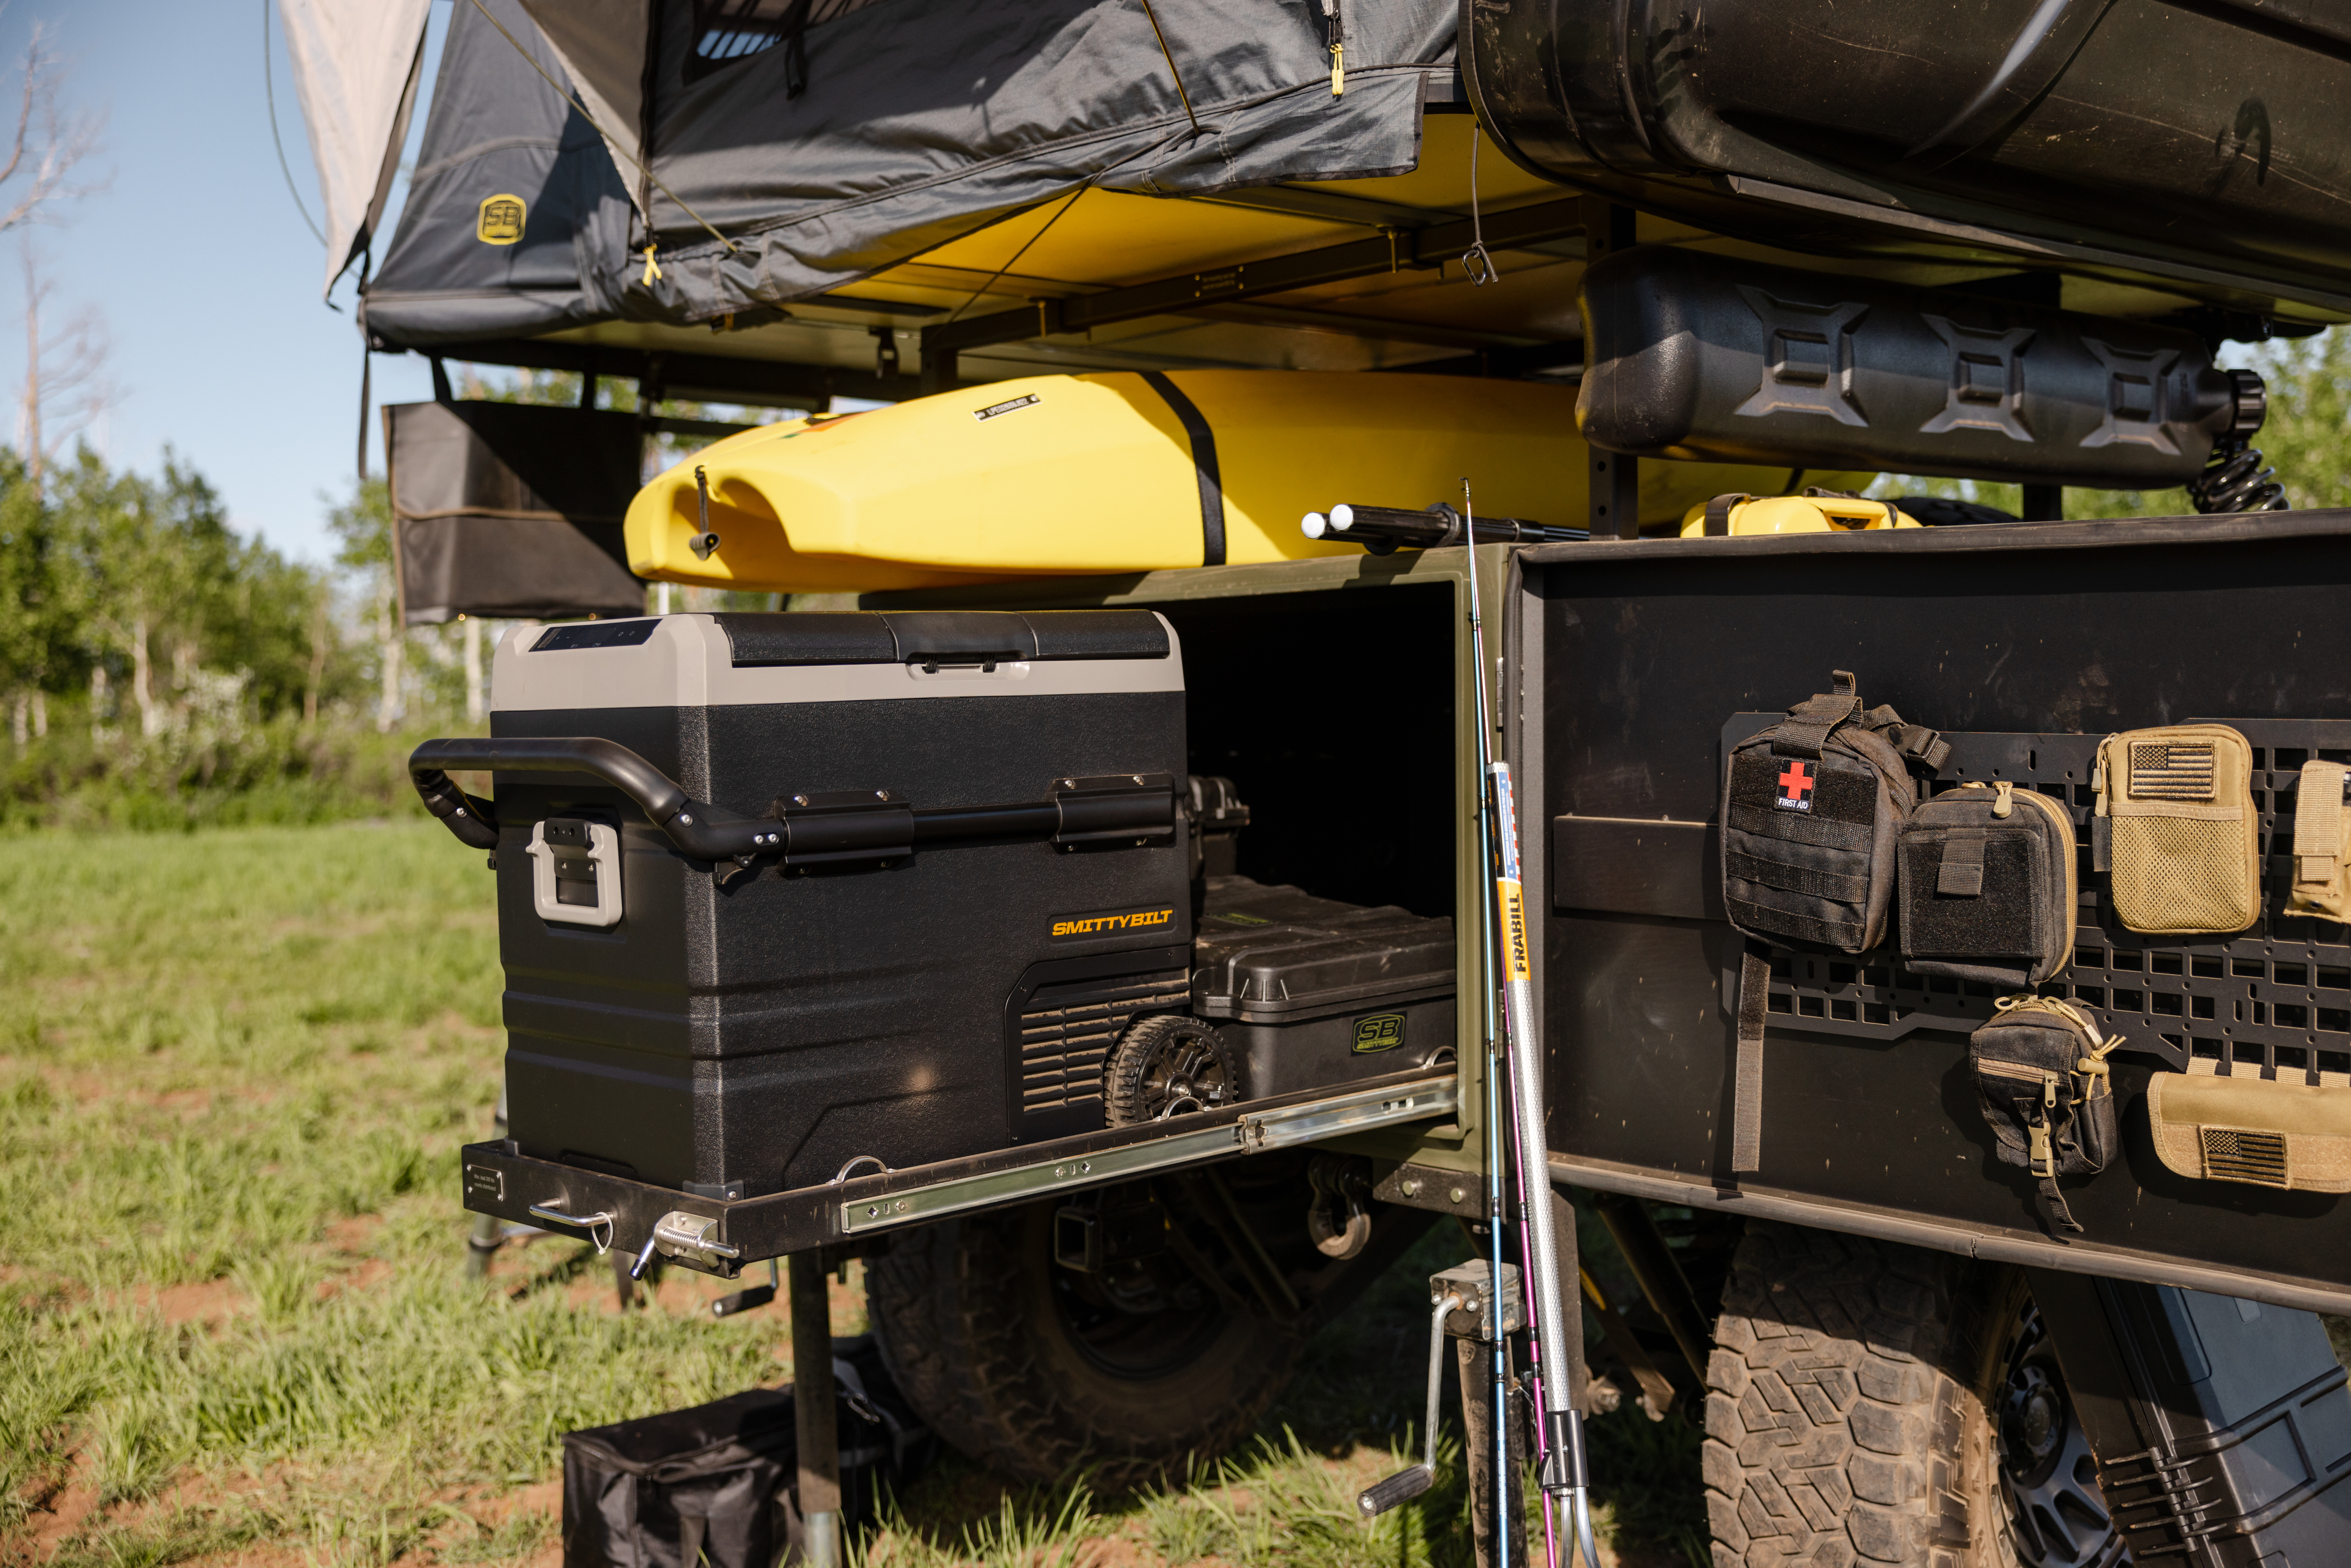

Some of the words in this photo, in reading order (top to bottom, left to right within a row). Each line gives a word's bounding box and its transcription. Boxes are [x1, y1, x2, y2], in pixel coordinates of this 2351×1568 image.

[1778, 798, 1797, 808] FIRST
[1052, 909, 1173, 936] SMITTYBILT
[1508, 893, 1526, 972] FRABILL
[1357, 1017, 1401, 1043] SB
